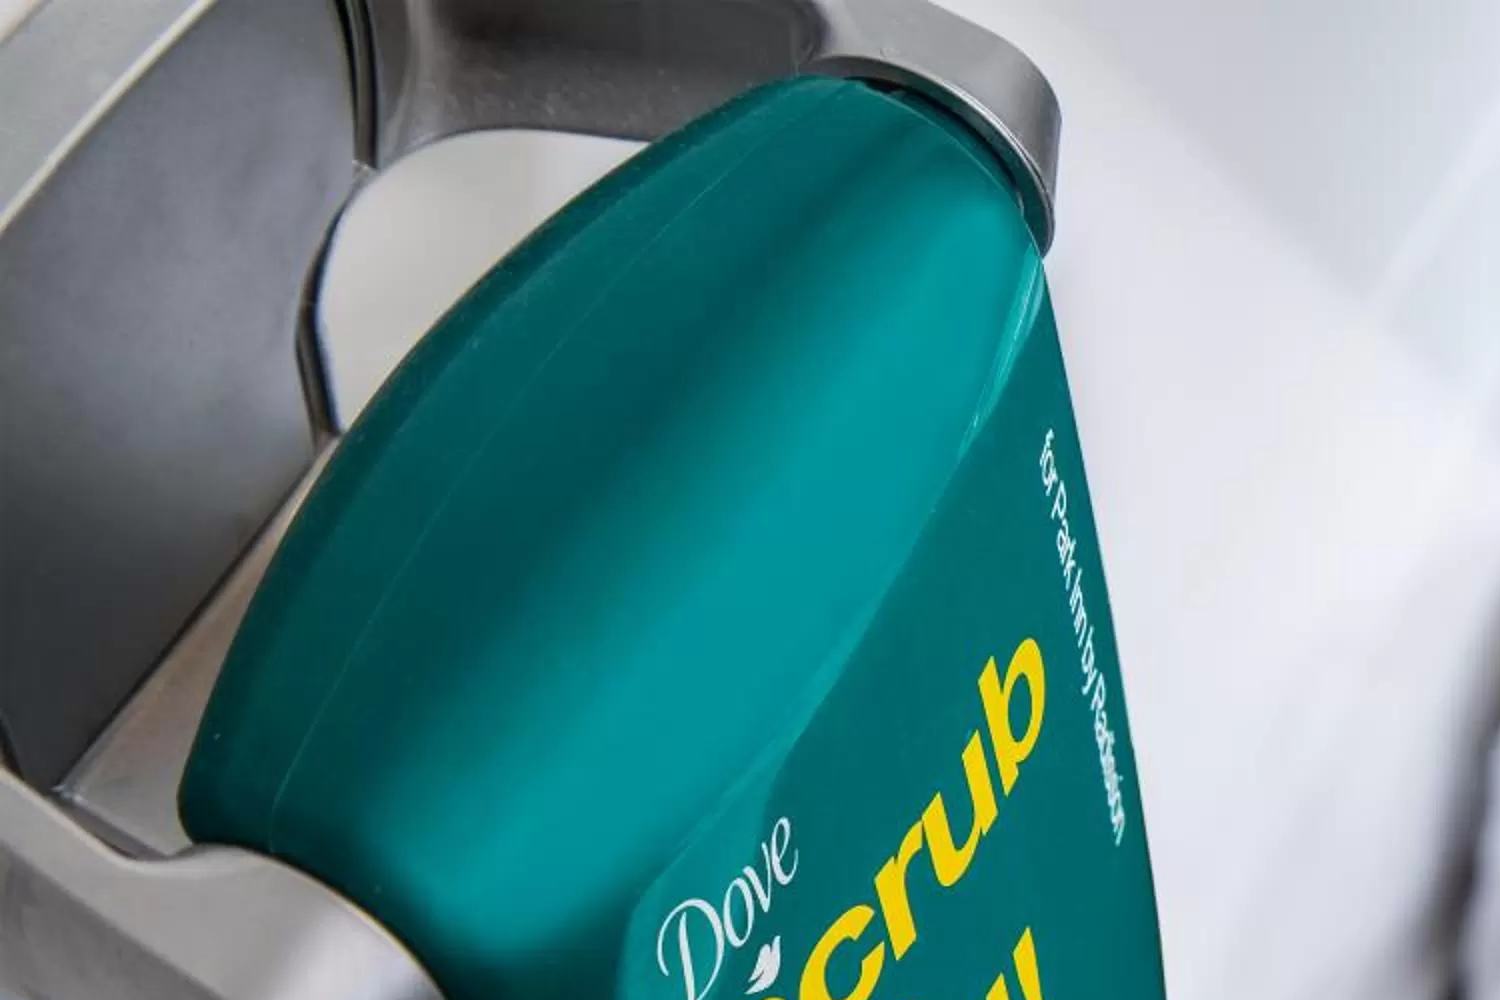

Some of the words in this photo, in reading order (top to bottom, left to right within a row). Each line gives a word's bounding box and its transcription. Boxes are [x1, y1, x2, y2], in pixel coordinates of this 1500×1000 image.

[1040, 428, 1058, 496] for
[1052, 480, 1077, 591] Park
[1069, 567, 1088, 649] Inn
[1081, 625, 1098, 695] by
